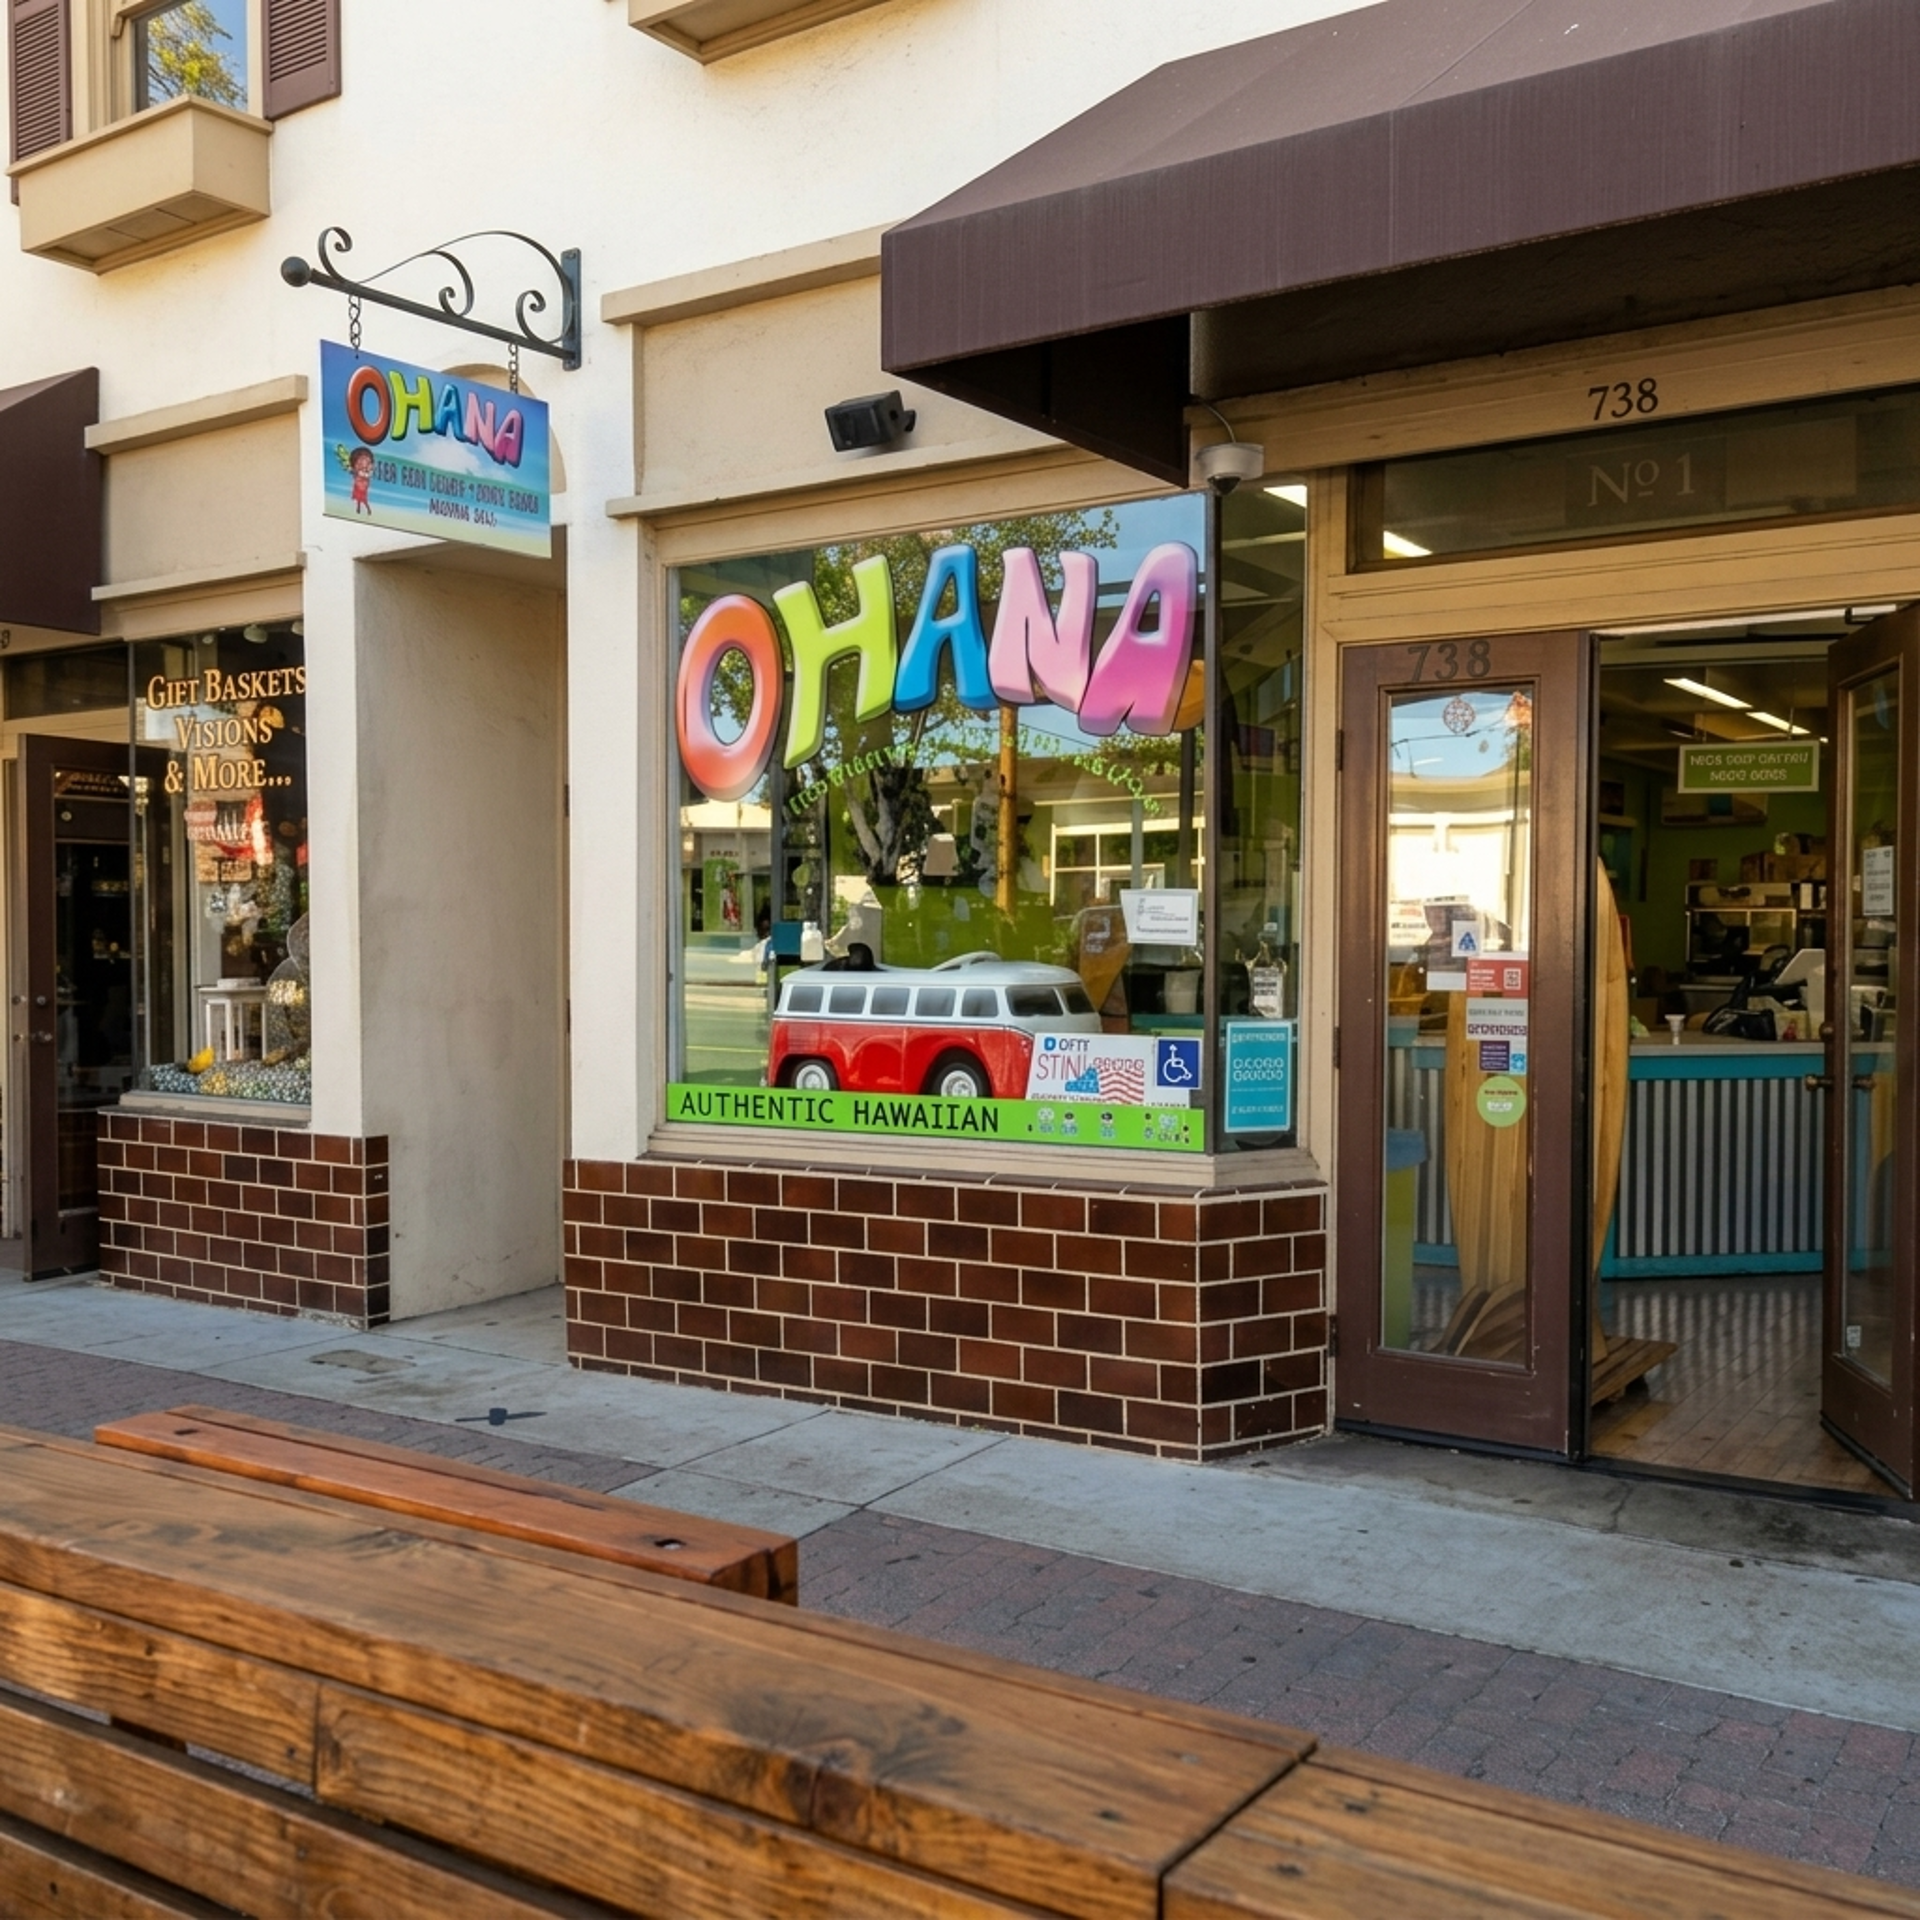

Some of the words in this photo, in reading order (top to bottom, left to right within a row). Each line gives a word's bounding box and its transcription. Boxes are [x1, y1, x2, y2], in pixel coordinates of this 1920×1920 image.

[346, 364, 524, 469] OHANA
[1588, 378, 1659, 421] 738
[676, 543, 1198, 801] OHANA
[1408, 640, 1491, 684] 738
[164, 760, 184, 793] &
[680, 1091, 834, 1124] AUTHENTIC
[854, 1099, 999, 1133] HAWAIIAN
